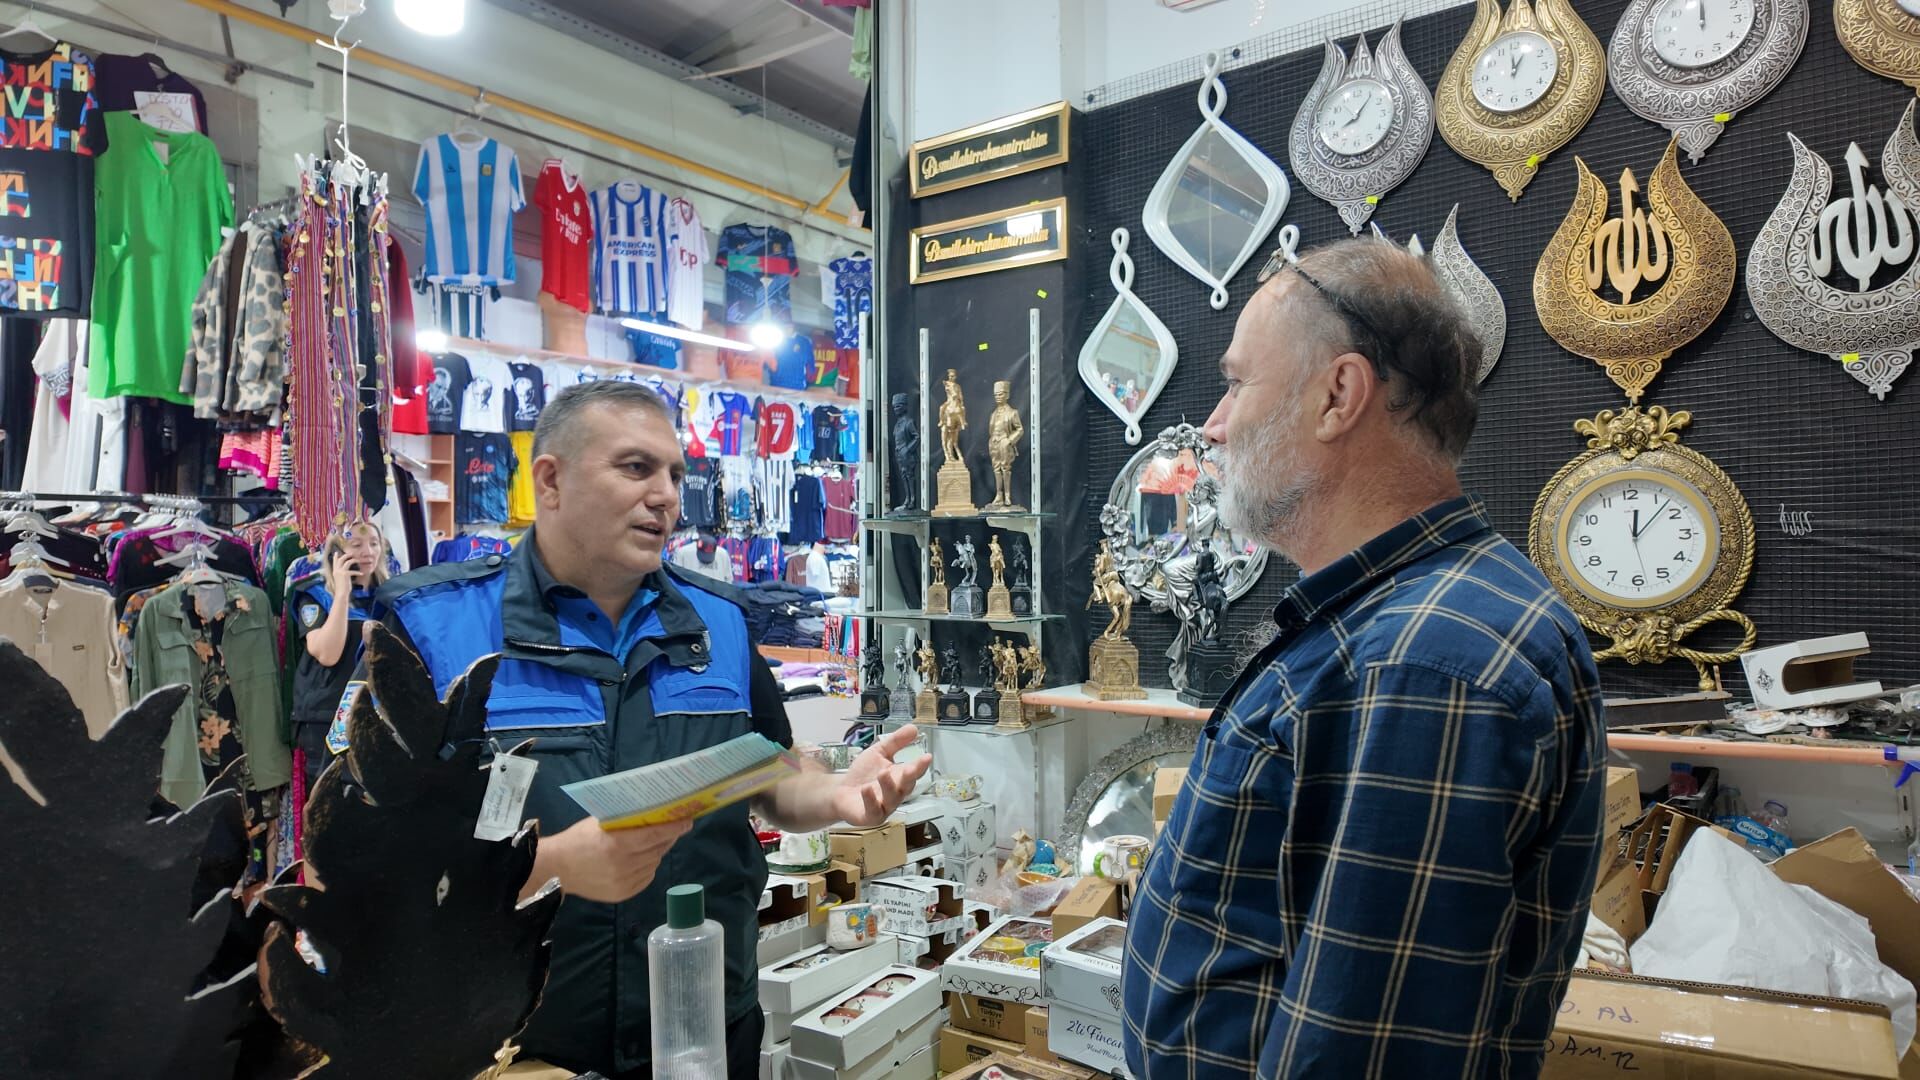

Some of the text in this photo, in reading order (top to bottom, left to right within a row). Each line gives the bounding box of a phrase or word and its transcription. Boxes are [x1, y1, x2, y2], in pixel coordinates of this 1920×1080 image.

[1695, 49, 1704, 59] 6
[607, 240, 656, 250] AMERICAN
[613, 249, 657, 258] EXPRESS
[815, 362, 824, 384] 7
[772, 418, 784, 444] 7
[1623, 489, 1639, 500] 12
[1654, 493, 1658, 504] 1
[1602, 497, 1612, 509] 11
[1585, 514, 1599, 525] 10
[1669, 508, 1681, 520] 2
[1679, 528, 1692, 540] 3
[1579, 535, 1592, 546] 9
[1588, 555, 1602, 566] 8
[1673, 550, 1686, 562] 4
[1607, 570, 1618, 582] 7
[1656, 567, 1670, 578] 5
[1631, 575, 1645, 587] 6
